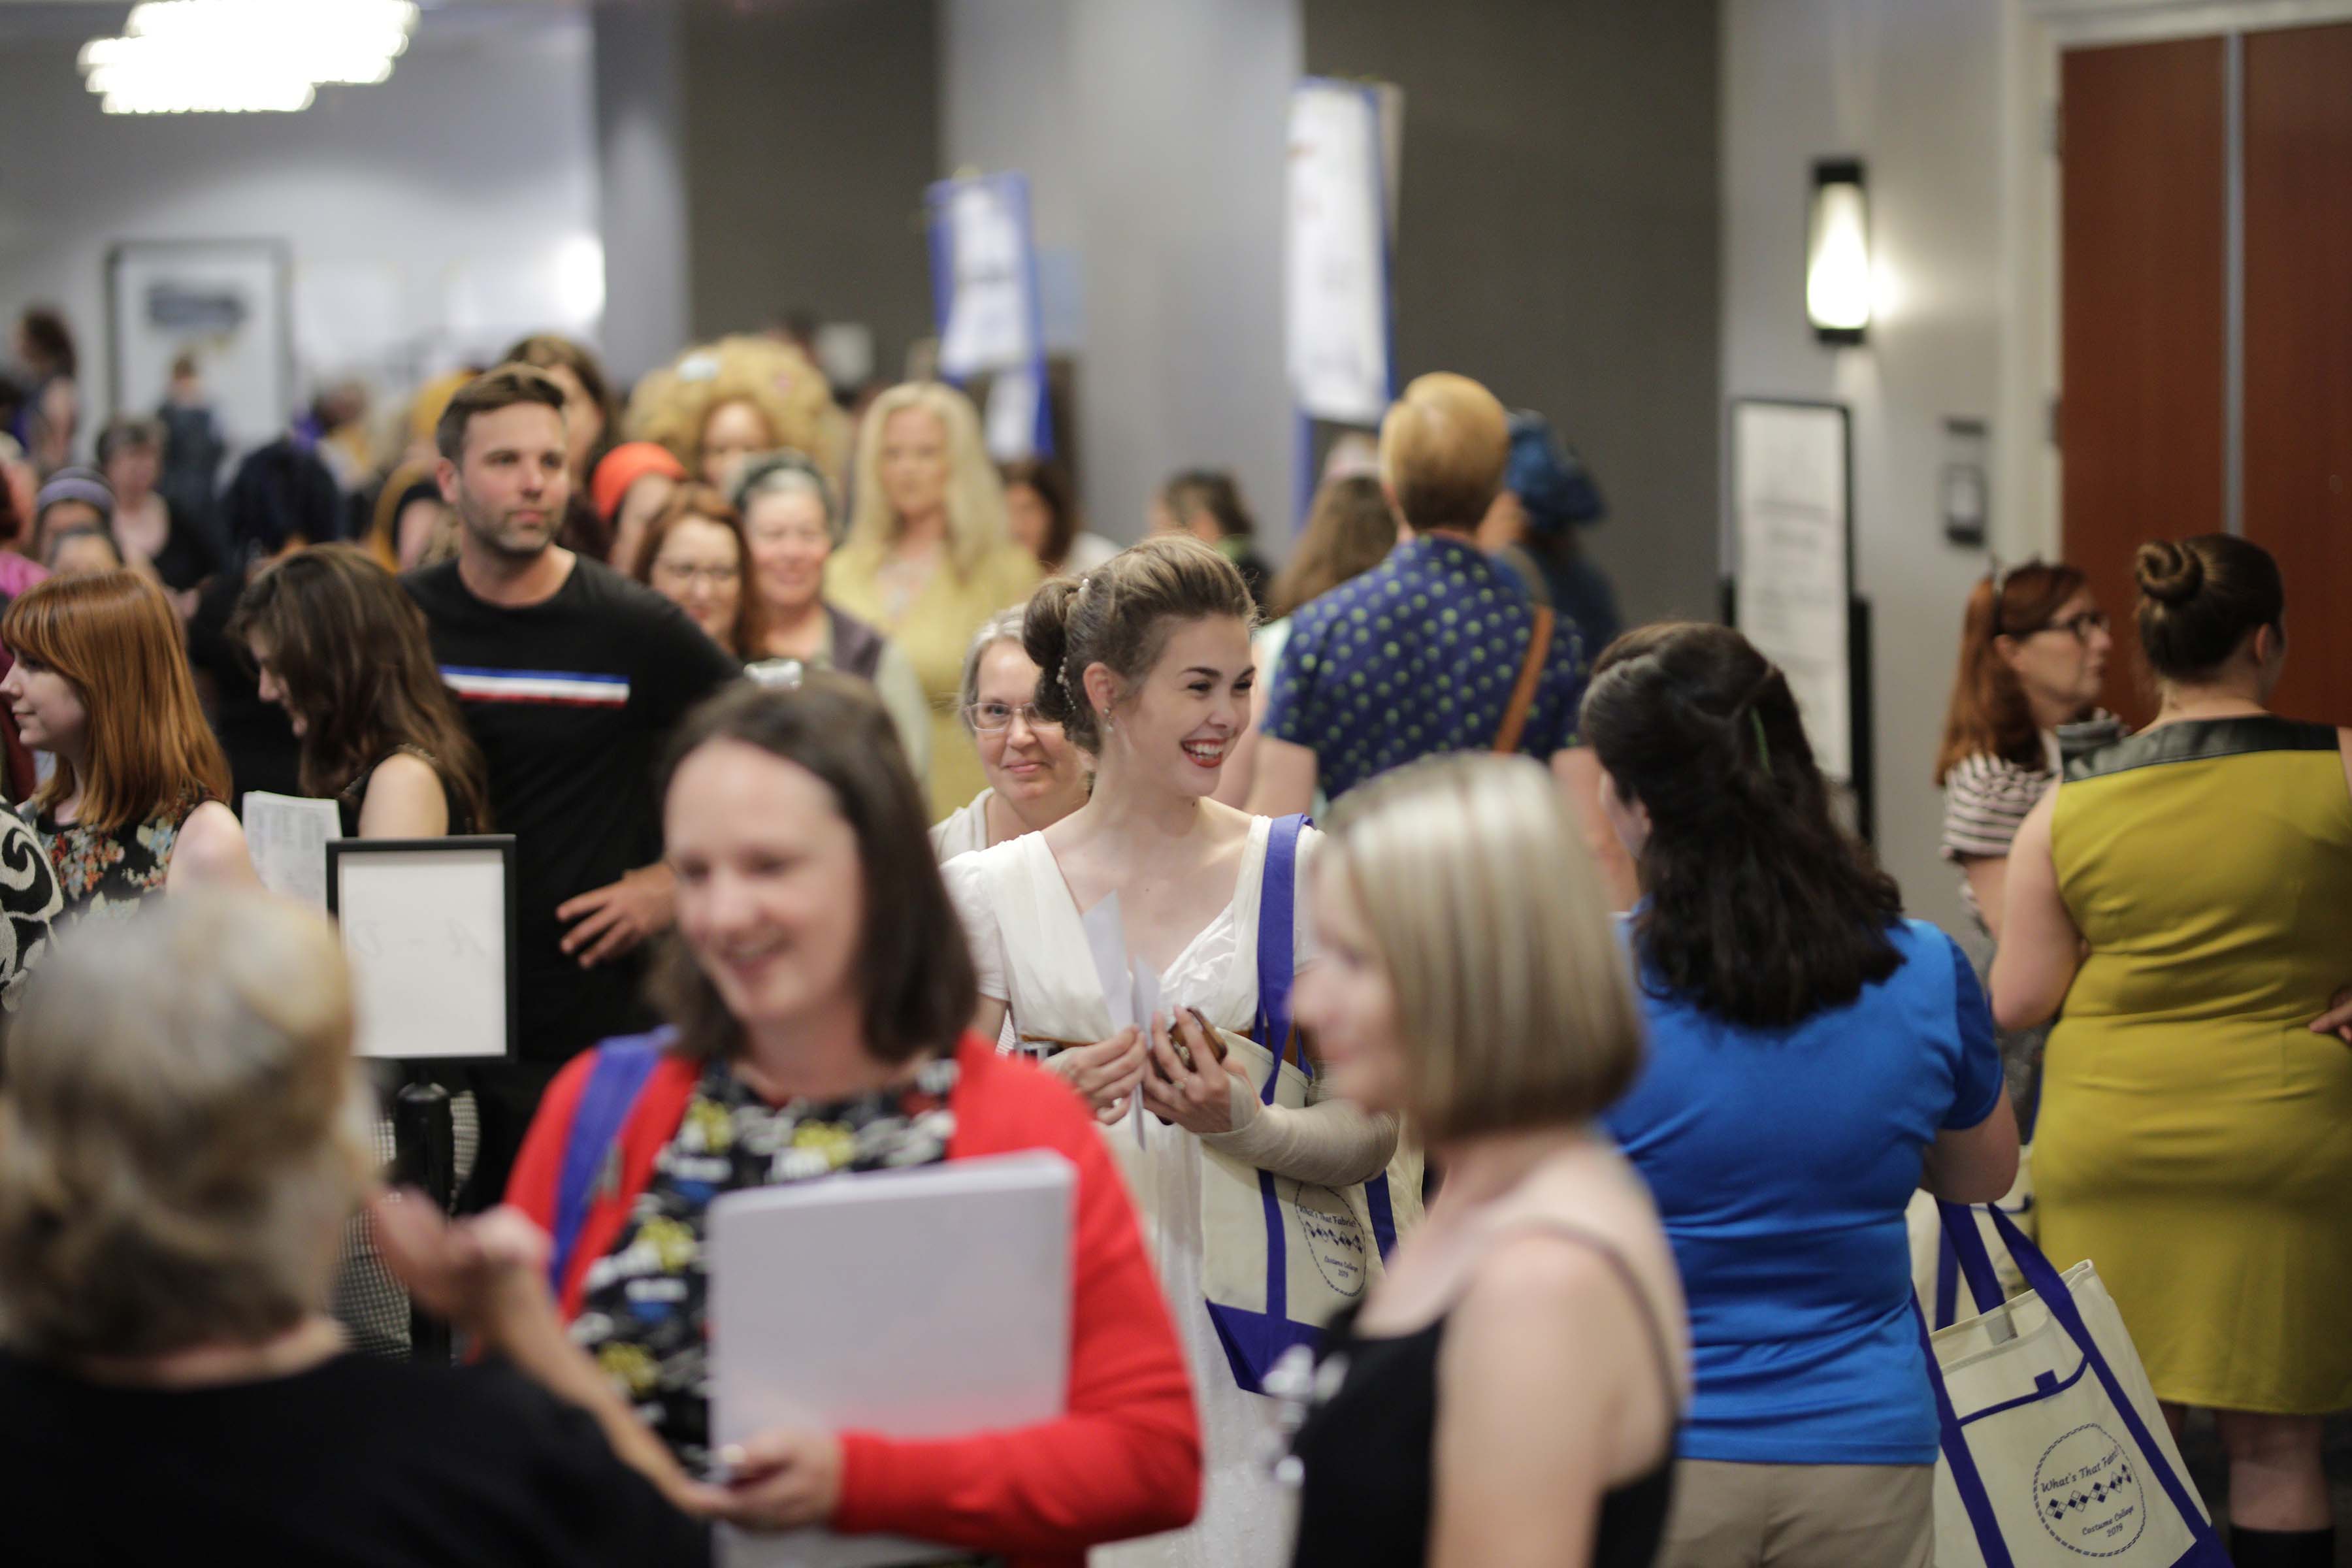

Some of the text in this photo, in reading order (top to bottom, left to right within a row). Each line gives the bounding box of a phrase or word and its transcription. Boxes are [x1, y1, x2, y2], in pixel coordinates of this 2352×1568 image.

[2041, 1473, 2077, 1493] What's
[2078, 1463, 2101, 1479] That
[2082, 1518, 2113, 1535] Costume
[2106, 1522, 2123, 1537] 2019
